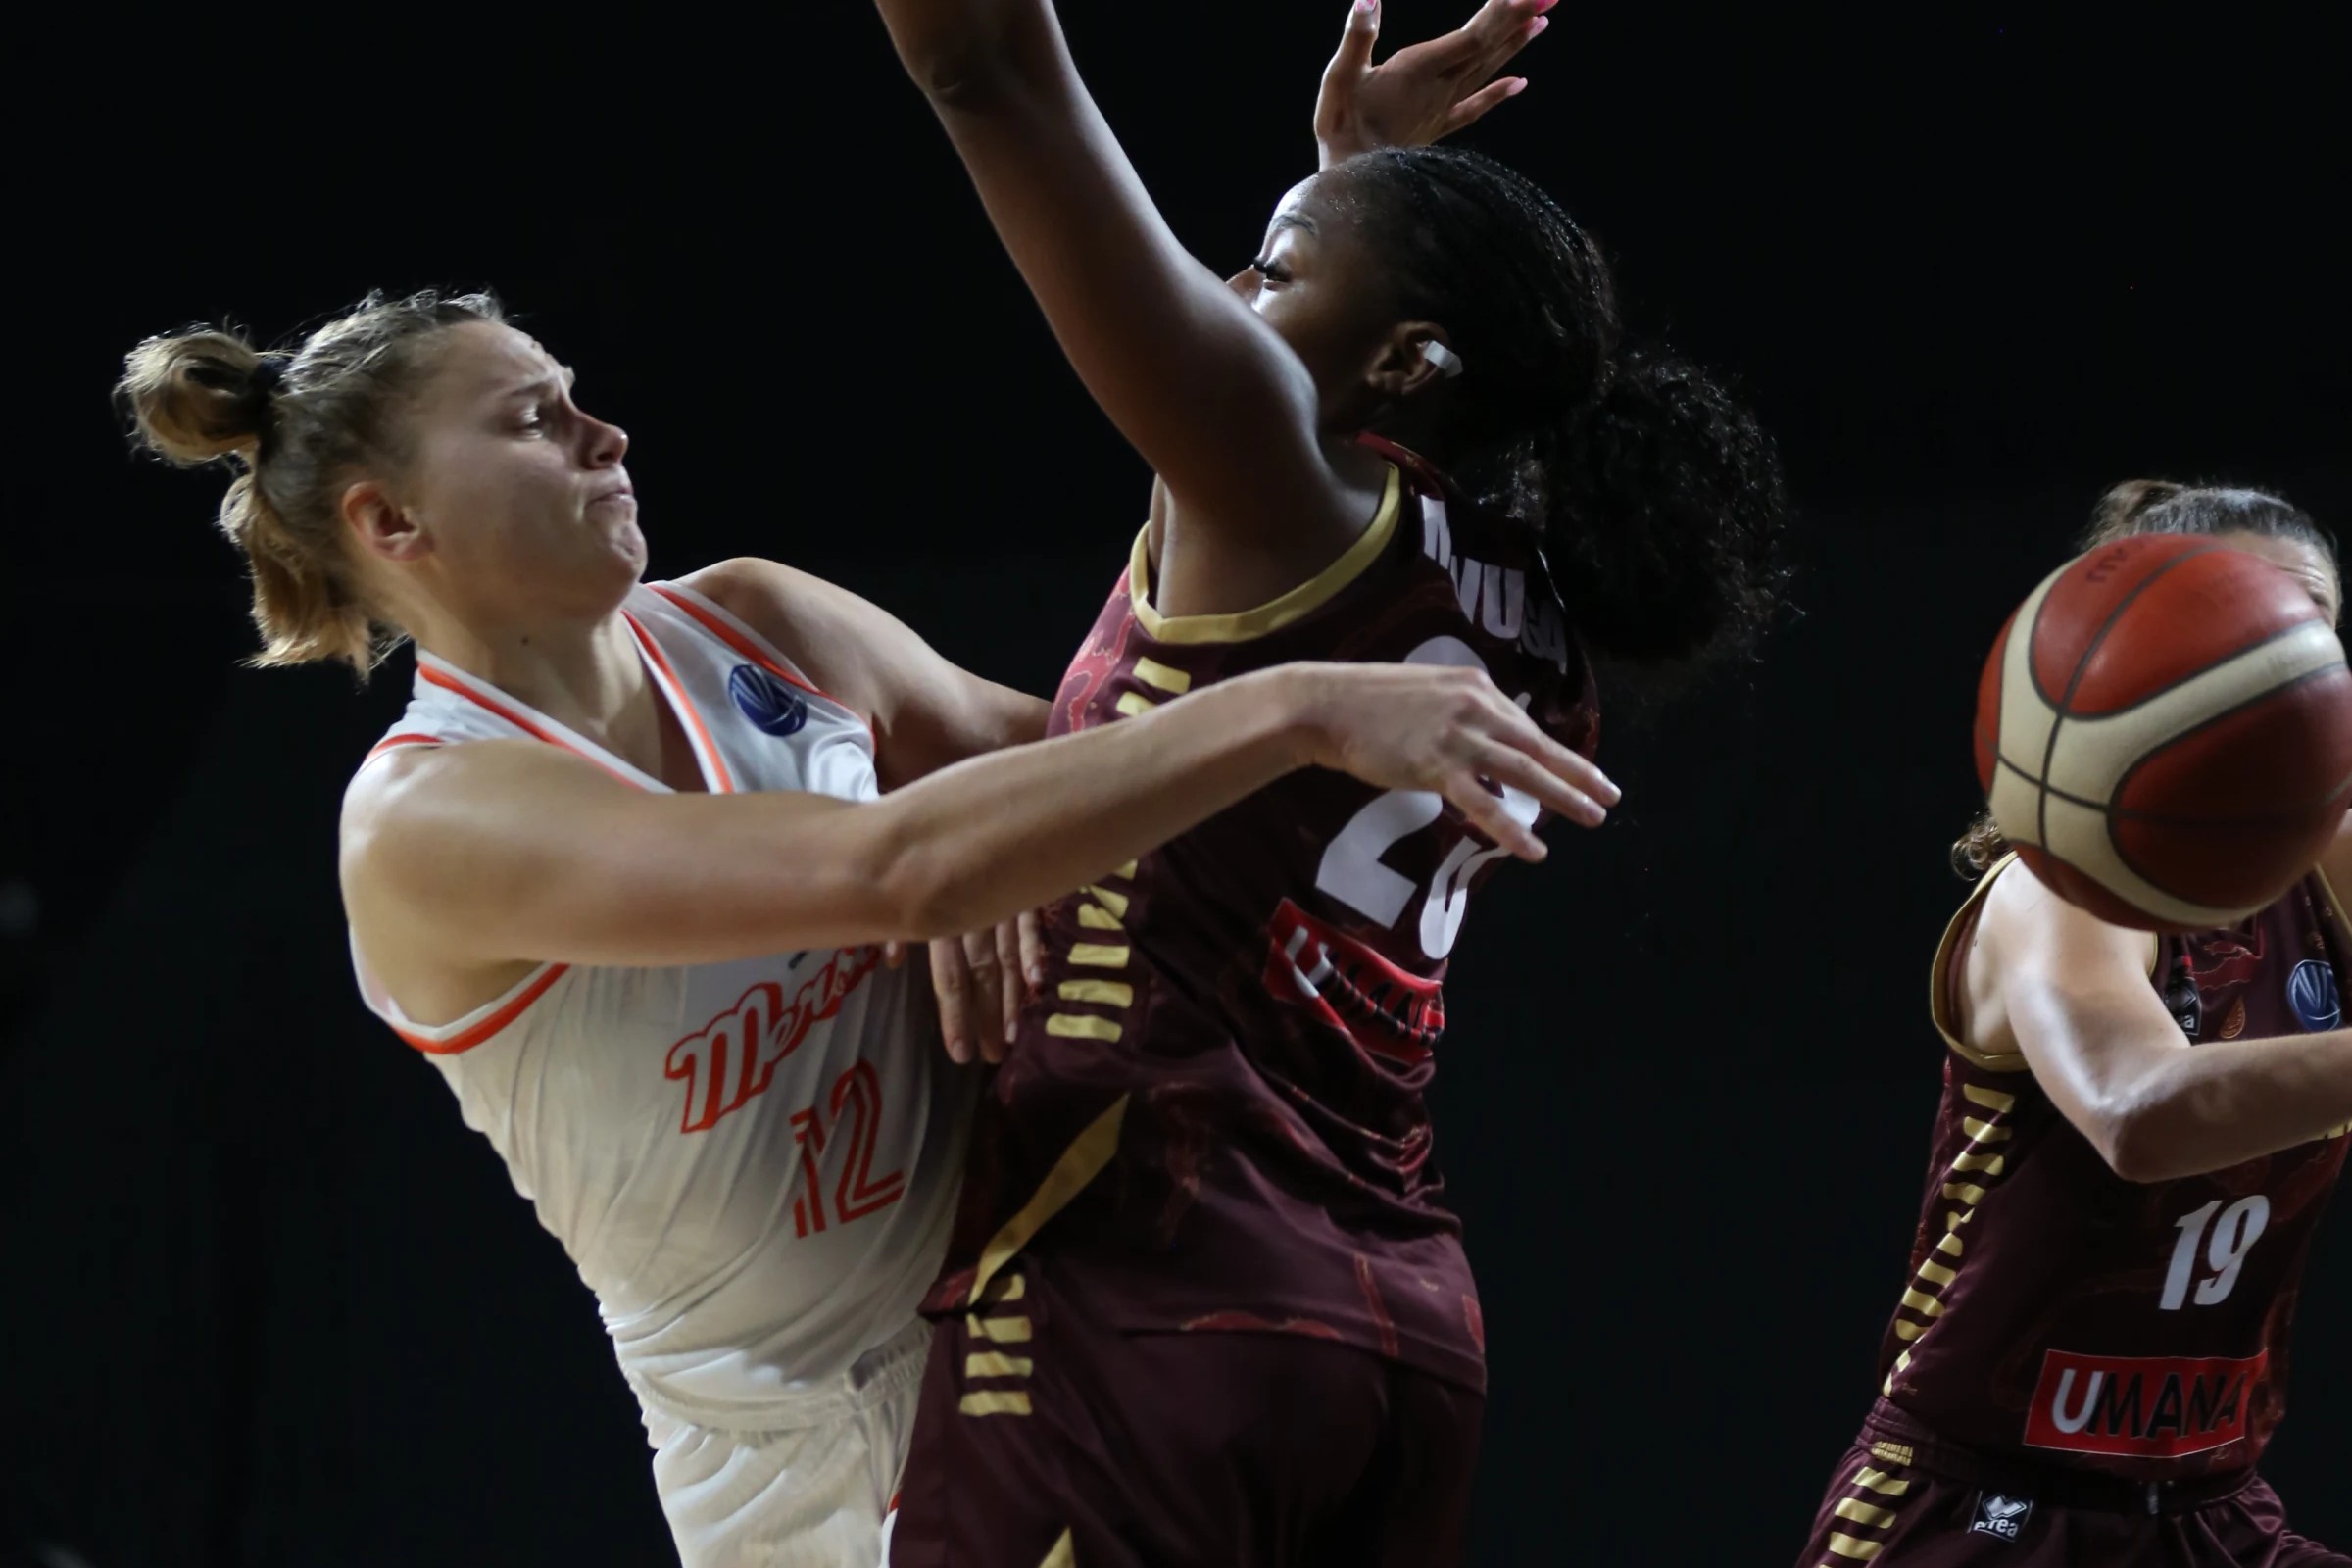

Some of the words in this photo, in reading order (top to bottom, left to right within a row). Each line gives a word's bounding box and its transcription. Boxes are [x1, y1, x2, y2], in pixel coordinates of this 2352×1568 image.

[790, 1058, 905, 1239] 12
[2159, 1195, 2271, 1310] 19
[2051, 1367, 2251, 1439] UMANA
